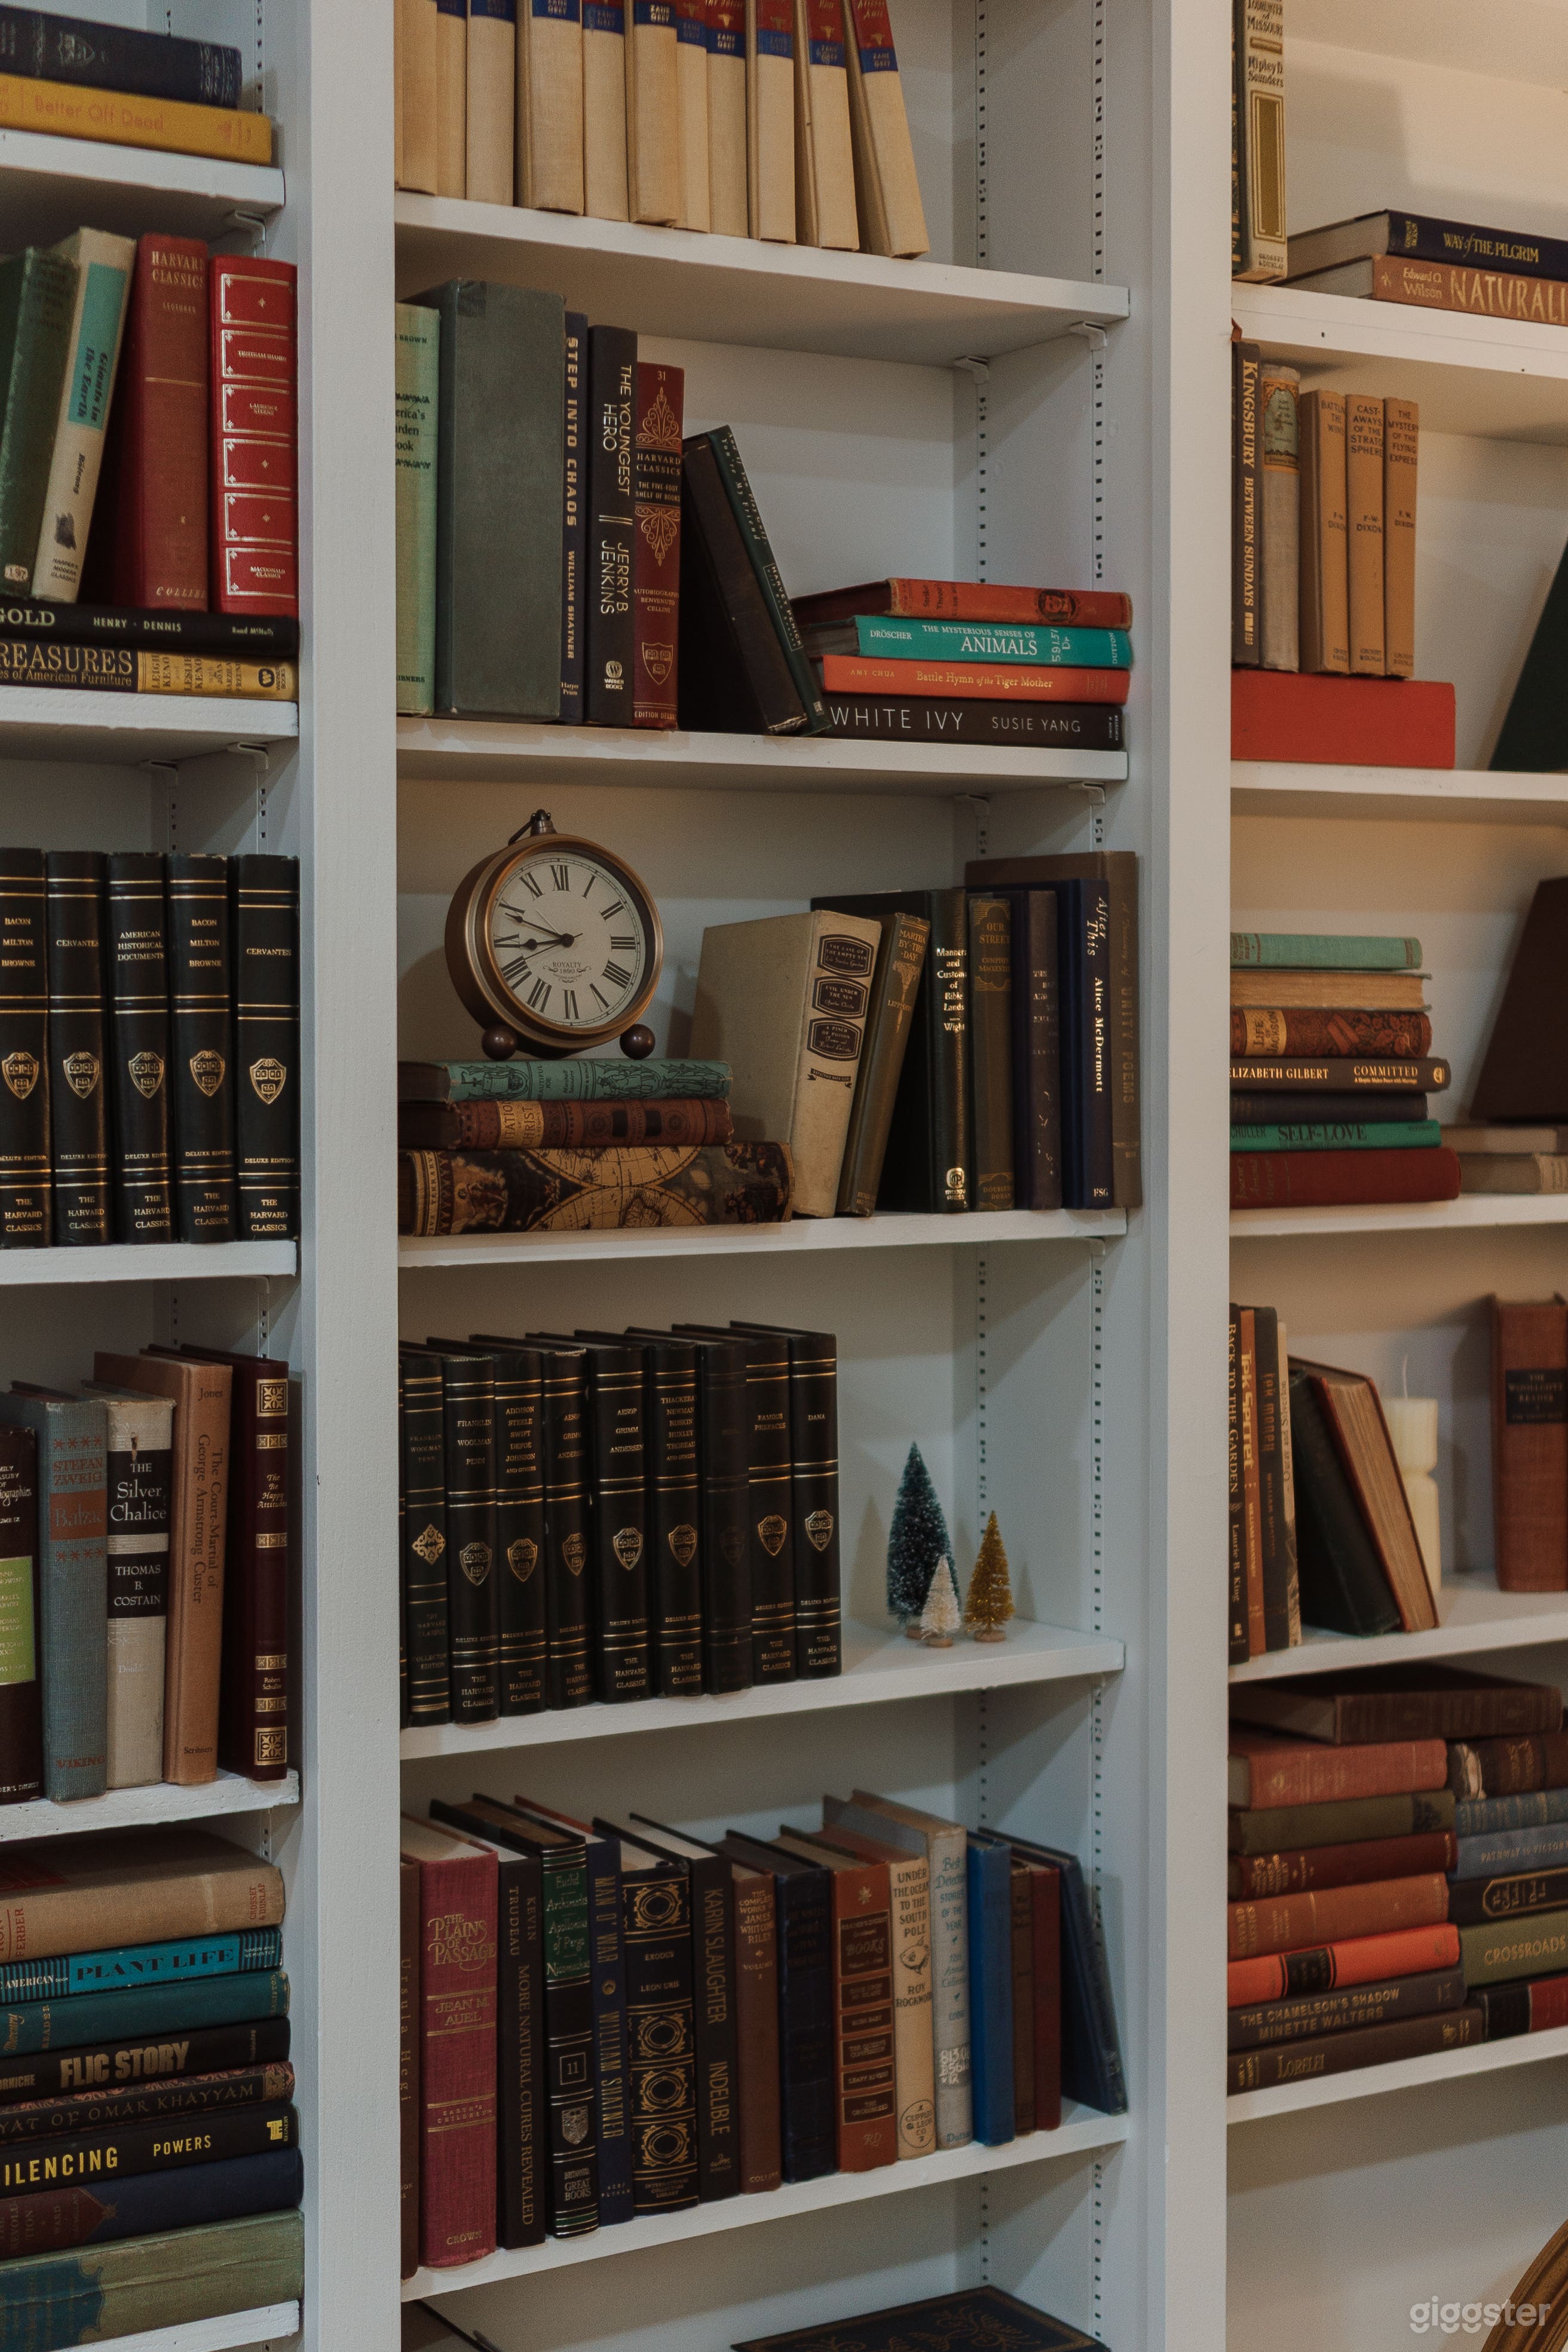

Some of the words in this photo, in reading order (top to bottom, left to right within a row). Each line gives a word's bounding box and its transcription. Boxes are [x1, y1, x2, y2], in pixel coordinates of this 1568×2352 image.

[35, 96, 82, 117] Better
[89, 104, 114, 124] Off
[122, 112, 163, 133] Dead
[1444, 232, 1463, 250] WAY
[1472, 238, 1494, 255] THE
[1495, 243, 1539, 263] PILGRIM
[1403, 280, 1443, 300] Wilson
[567, 338, 578, 388] STEP
[621, 365, 631, 397] THE
[658, 371, 666, 380] 31
[568, 399, 577, 447] INTO
[1242, 360, 1258, 468] KINGSBURY
[604, 404, 617, 451] HERO
[618, 402, 630, 496] YOUNGEST
[637, 453, 681, 465] HARVARD
[636, 464, 680, 476] CLASSICS
[567, 459, 577, 526] CHAOS
[1244, 477, 1254, 544] BETWEEN
[601, 540, 615, 614] JENKINS
[617, 543, 629, 599] JERRY
[1244, 547, 1254, 607] SUNDAYS
[617, 602, 628, 614] B.
[94, 617, 126, 629] HENRY
[144, 620, 182, 632] DENNIS
[870, 628, 912, 639] DRÖSCHER
[942, 626, 992, 636] MYSTERIOUS
[994, 629, 1022, 638] SENSES
[961, 637, 1037, 656] ANIMALS
[13, 669, 23, 679] of
[26, 669, 76, 683] American
[80, 673, 131, 685] Furniture
[917, 671, 943, 683] Battle
[946, 672, 973, 686] Hymn
[976, 676, 984, 687] of
[995, 675, 1018, 688] Tiger
[1021, 677, 1053, 688] Mother
[831, 707, 911, 729] WHITE
[927, 711, 963, 730] IVY
[993, 717, 1033, 730] SUSIE
[1042, 719, 1081, 732] YANG
[987, 923, 1004, 932] OUR
[1098, 898, 1109, 939] After
[120, 930, 160, 939] AMERICAN
[899, 929, 925, 944] MARTHA
[1087, 920, 1097, 956] This
[118, 953, 164, 961] DOCUMENTS
[945, 992, 963, 1000] Bible
[1094, 978, 1102, 1012] Alice
[944, 1022, 964, 1033] Wight
[1253, 1020, 1264, 1047] LIFE
[1095, 1016, 1104, 1093] McDermott
[1286, 1068, 1329, 1079] GILBERT
[1353, 1065, 1418, 1077] COMMITTED
[1278, 1123, 1367, 1141] SELF-LOVE
[1094, 1189, 1108, 1198] FSG
[5, 1211, 42, 1219] HARVARD
[5, 1224, 42, 1232] CLASSICS
[198, 1388, 223, 1400] Jones
[506, 1406, 534, 1414] ADDISON
[53, 1458, 102, 1473] STEFAN
[194, 1435, 210, 1481] George
[212, 1448, 222, 1476] The
[1229, 1429, 1238, 1494] GARDEN
[131, 1463, 151, 1473] THE
[53, 1472, 102, 1486] ZWEIG
[118, 1483, 162, 1499] Silver
[111, 1505, 167, 1523] Chalice
[191, 1487, 207, 1555] Armstrong
[209, 1481, 222, 1571] Court-Martial
[116, 1565, 160, 1575] THOMAS
[134, 1581, 143, 1590] B.
[193, 1561, 206, 1603] Custer
[209, 1576, 218, 1588] of
[115, 1595, 160, 1606] COSTAIN
[57, 1755, 105, 1769] VIKING
[555, 1873, 579, 1888] Euclid
[897, 1867, 927, 1885] UNDER
[595, 1876, 616, 1907] MAN
[704, 1888, 724, 1934] KARIN
[900, 1900, 911, 1910] TO
[912, 1896, 926, 1909] THE
[445, 1913, 464, 1924] THE
[509, 1886, 519, 1956] TRUDEAU
[527, 1897, 535, 1941] KEVIN
[899, 1910, 927, 1925] SOUTH
[16, 1909, 26, 1957] FERBER
[428, 1918, 487, 1944] PLAINS
[904, 1924, 926, 1938] POLE
[448, 1938, 460, 1948] OF
[597, 1934, 618, 1963] WAR
[846, 1937, 886, 1956] BOOKS
[1484, 1934, 1566, 1967] CROSSROADS
[77, 1957, 163, 1982] PLANT
[173, 1949, 234, 1968] LIFE
[428, 1943, 497, 1971] PASSAGE
[645, 1951, 674, 1961] EXODUS
[5, 1975, 54, 1987] AMERICAN
[518, 1965, 529, 2012] MORE
[641, 1982, 661, 1992] LEON
[664, 1981, 679, 1989] URIS
[705, 1937, 727, 2025] SLAUGHTER
[907, 1982, 926, 1995] ROY
[436, 1998, 473, 2013] JEAN
[476, 1998, 489, 2008] M.
[1240, 2013, 1263, 2028] THE
[1267, 1992, 1349, 2023] CHAMELEON'S
[1352, 1987, 1399, 2007] SHADOW
[445, 2012, 481, 2026] AUEL
[1259, 2019, 1316, 2040] MINETTE
[1323, 2007, 1383, 2032] WALTERS
[599, 2010, 622, 2072] WILLIAM
[519, 2014, 531, 2088] NATURAL
[61, 2054, 110, 2088] FLIC
[115, 2042, 189, 2078] STORY
[51, 2110, 79, 2127] OF
[88, 2103, 149, 2121] OMAR
[158, 2084, 253, 2109] KHAYYAM
[709, 2061, 730, 2136] INDELIBLE
[520, 2091, 531, 2142] CURES
[601, 2078, 624, 2139] SHATNER
[154, 2135, 212, 2157] POWERS
[521, 2147, 533, 2225] REVEALED
[565, 2179, 590, 2191] GREAT
[565, 2188, 591, 2201] BOOKS
[446, 2230, 482, 2246] CROWN
